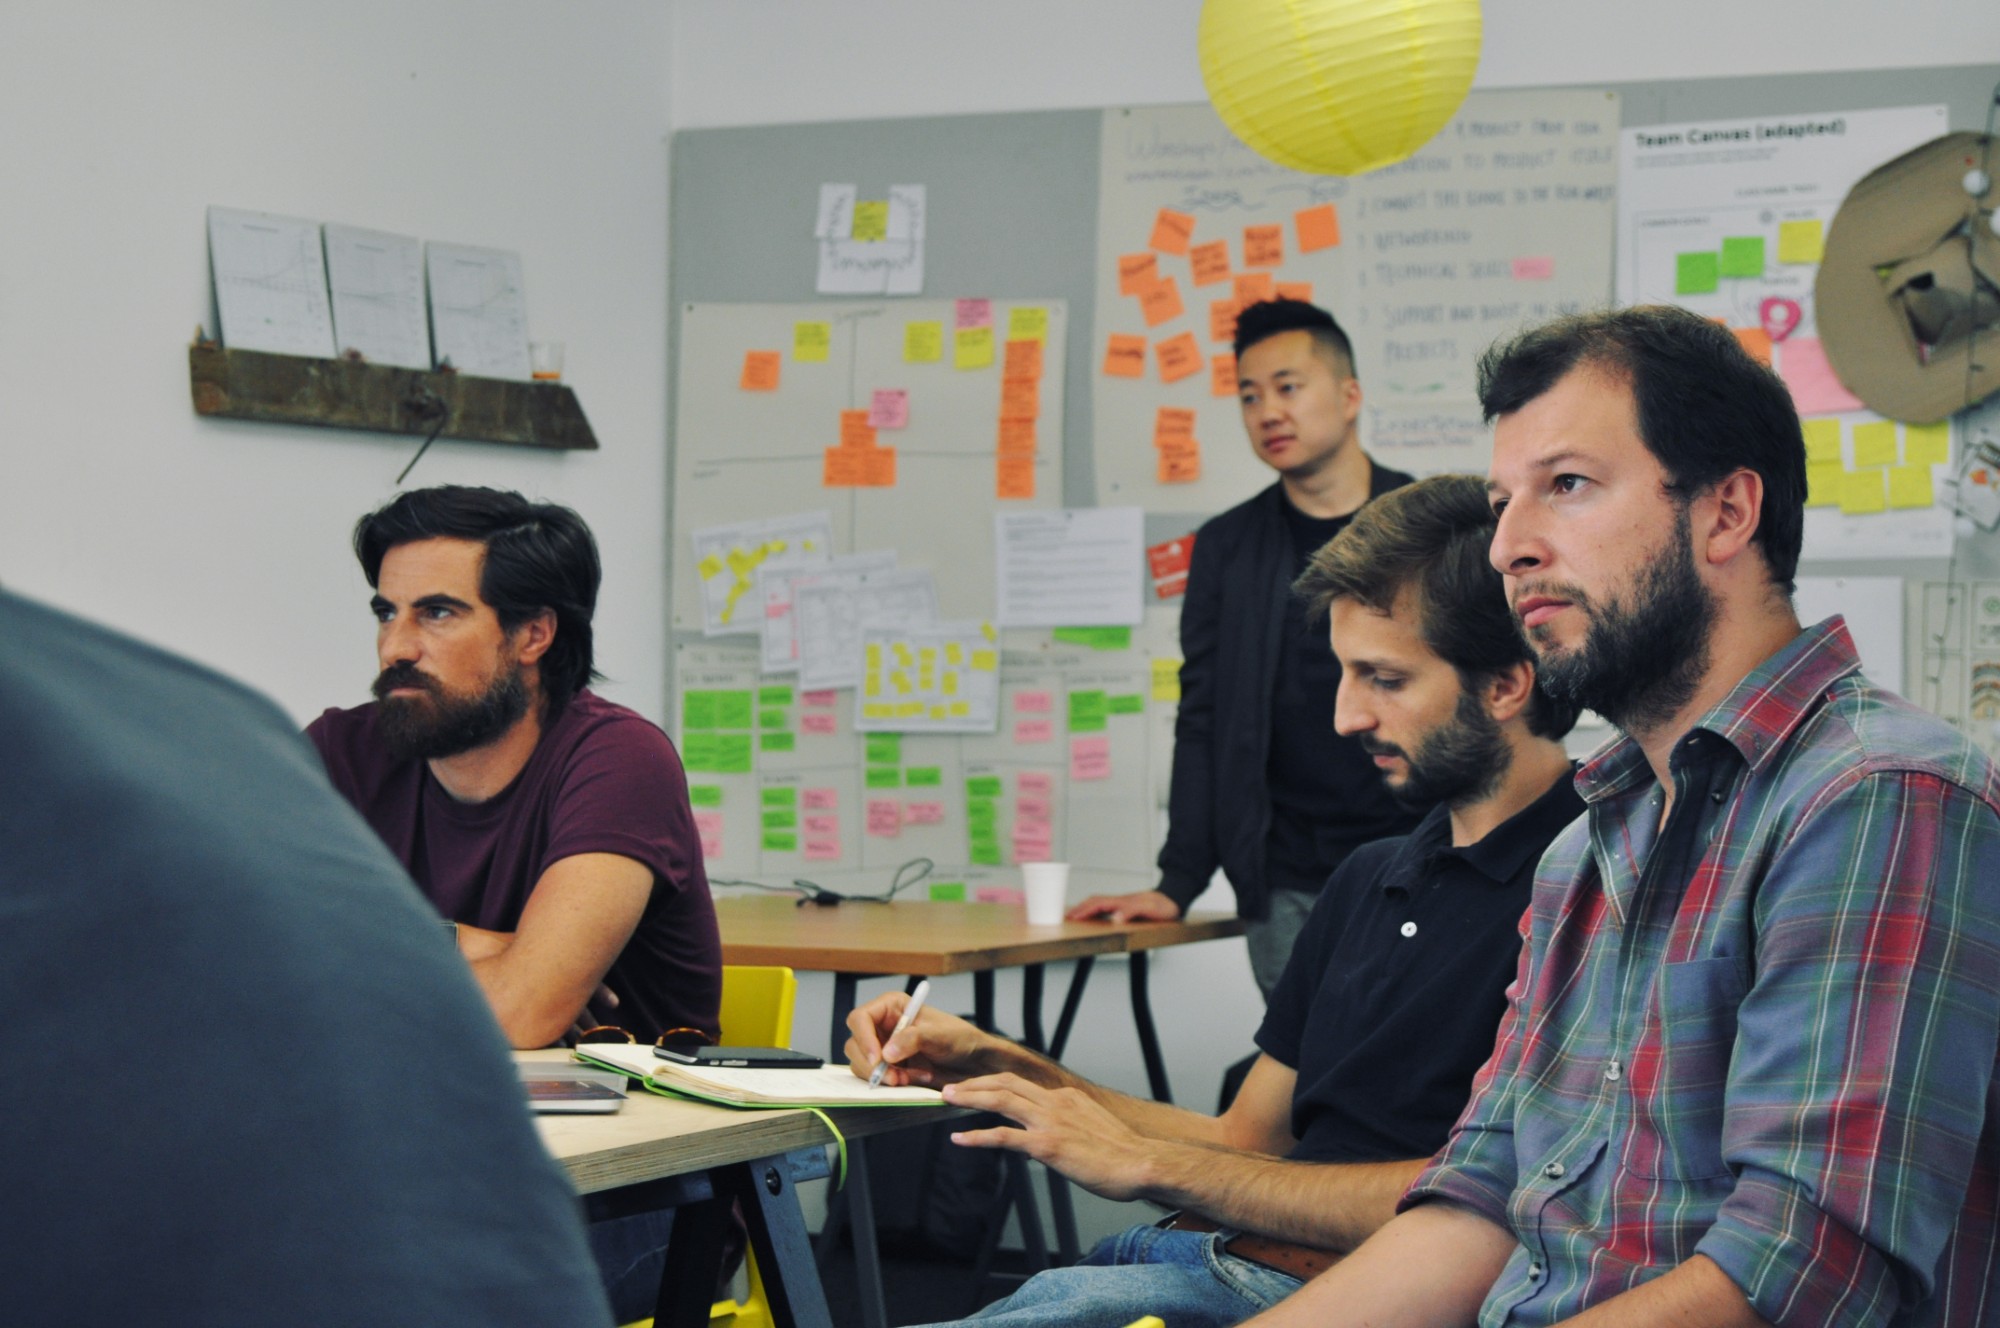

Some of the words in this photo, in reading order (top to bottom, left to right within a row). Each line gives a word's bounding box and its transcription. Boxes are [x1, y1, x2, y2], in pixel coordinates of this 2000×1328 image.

[1637, 133, 1682, 147] Team
[1686, 128, 1752, 146] Canvas
[1757, 119, 1845, 143] (adapted)
